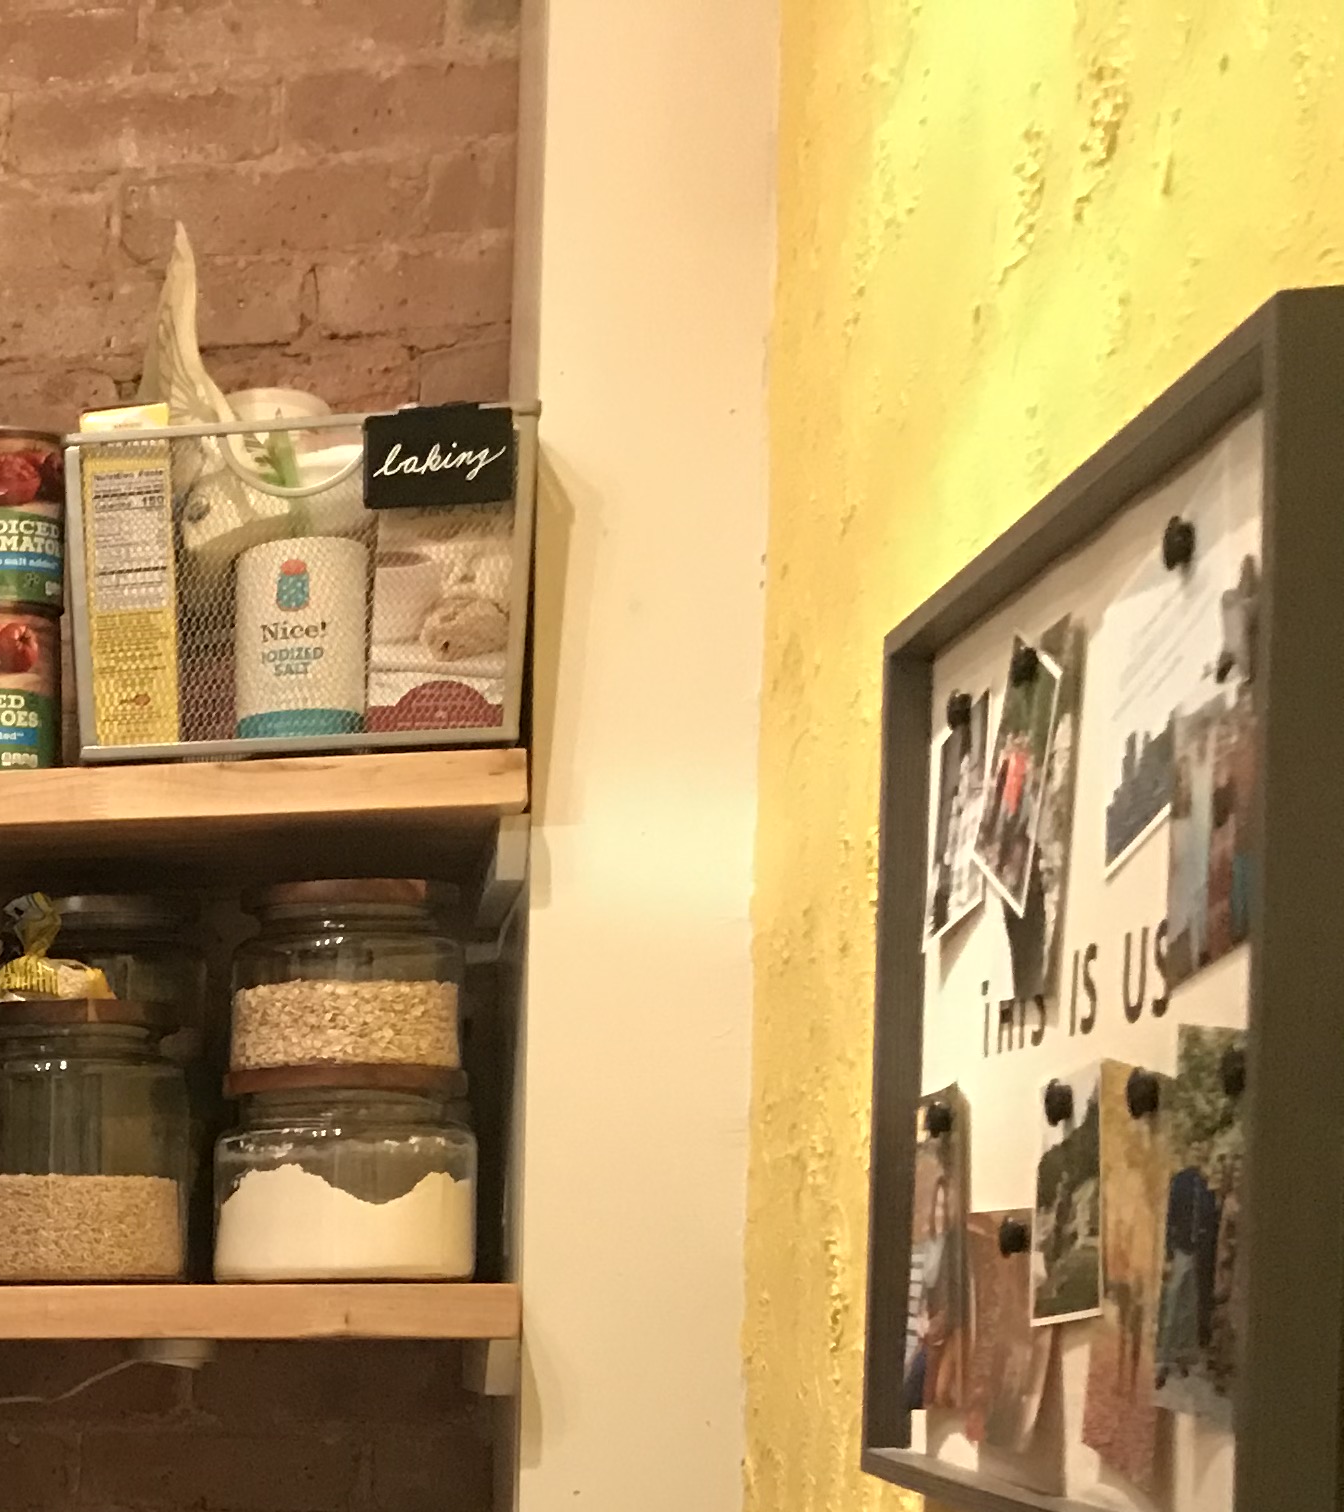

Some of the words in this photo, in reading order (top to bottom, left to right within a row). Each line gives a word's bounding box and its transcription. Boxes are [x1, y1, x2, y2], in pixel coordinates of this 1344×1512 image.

[372, 441, 507, 481] baking
[261, 620, 328, 644] Nice!
[1068, 942, 1099, 1037] IS
[1123, 918, 1171, 1024] US
